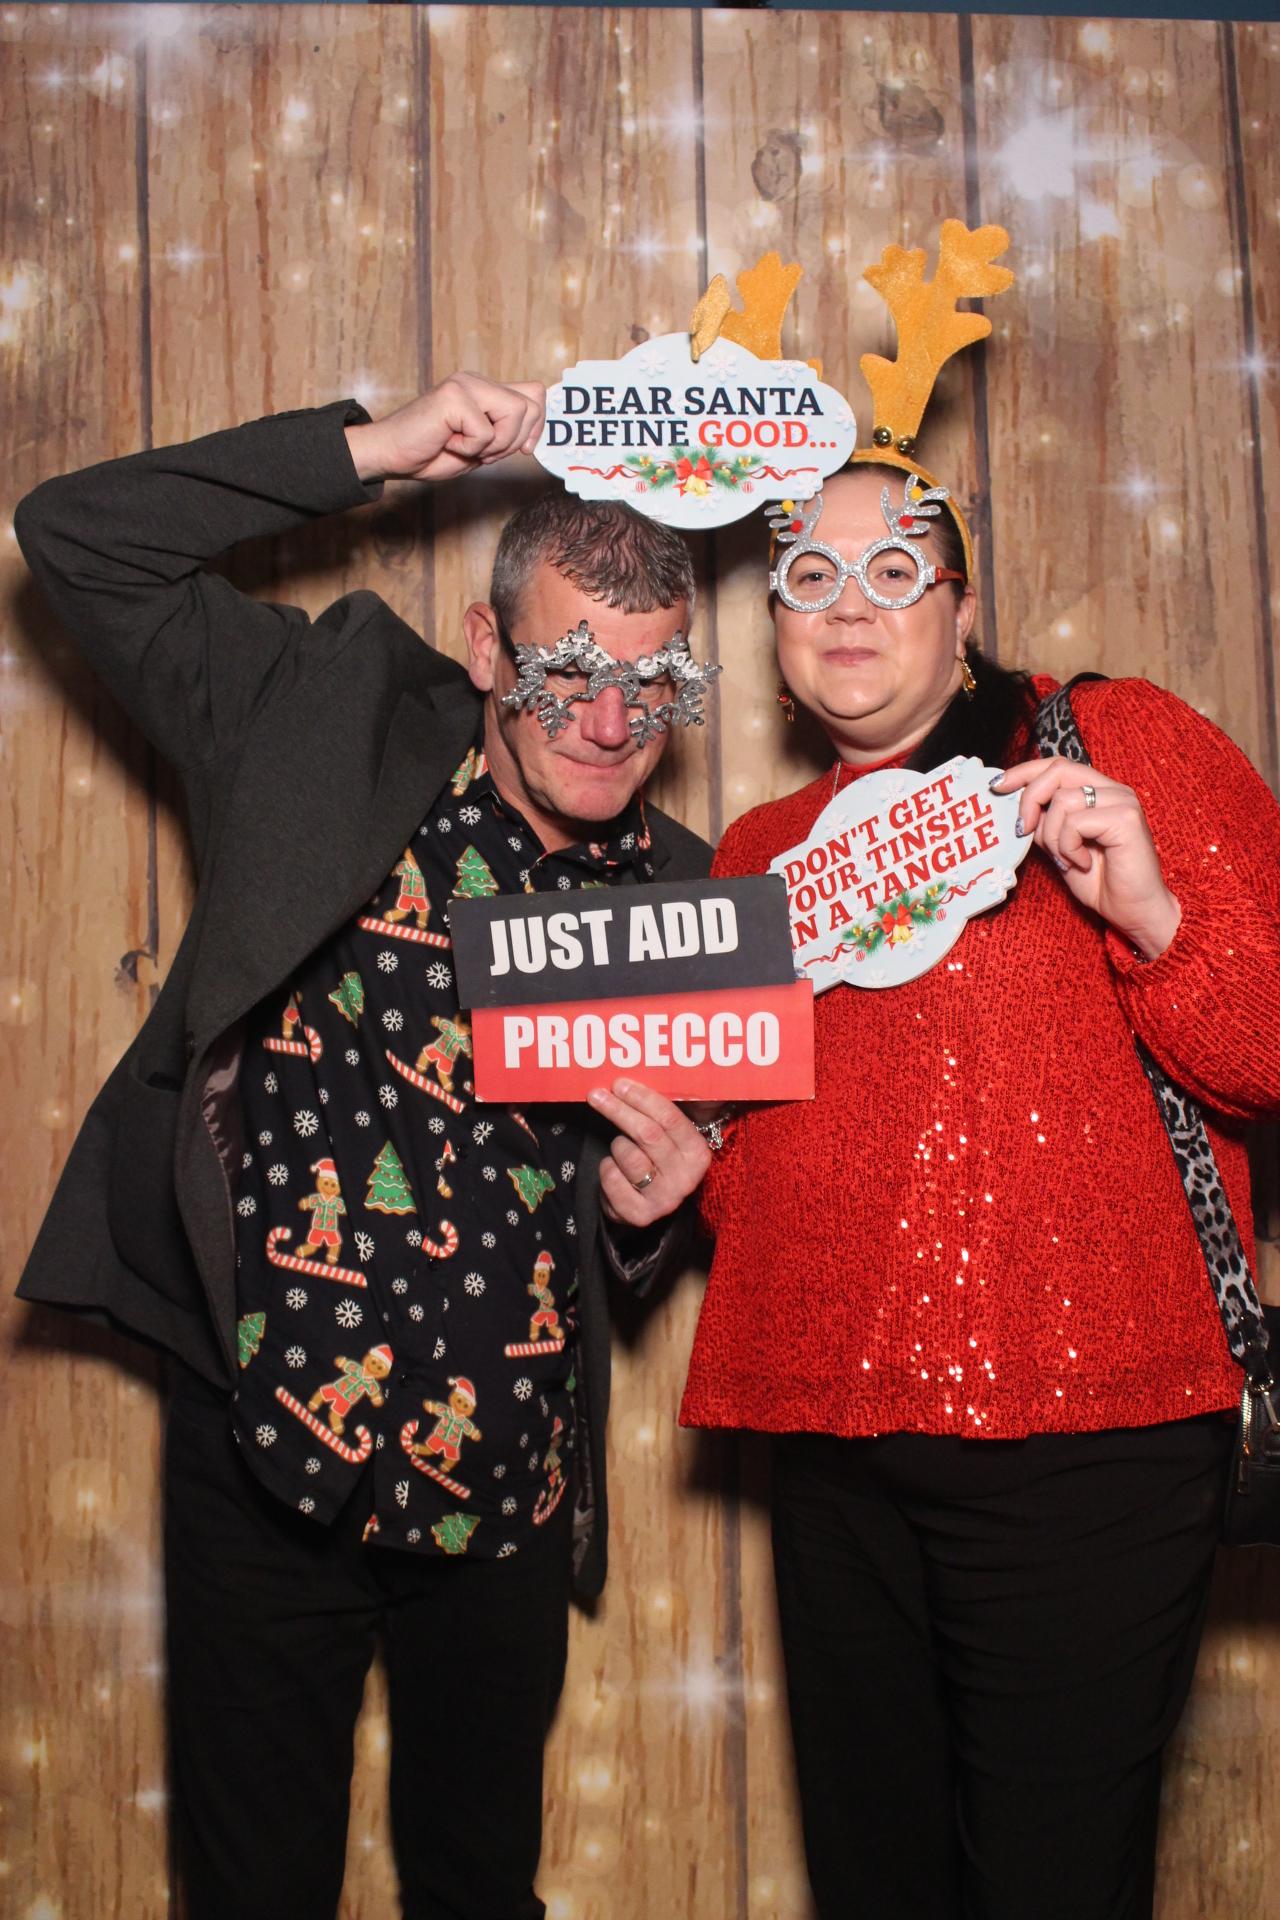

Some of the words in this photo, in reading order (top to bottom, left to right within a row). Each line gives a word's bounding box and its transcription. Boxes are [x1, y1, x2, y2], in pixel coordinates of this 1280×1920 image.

[546, 420, 689, 447] DEFINE
[698, 420, 838, 448] GOOD...
[562, 386, 675, 415] DEAR
[684, 386, 824, 416] SANTA
[784, 816, 880, 889] DON'T
[889, 774, 954, 829] GET
[866, 793, 993, 874] TINSEL
[790, 916, 819, 950] N
[829, 901, 854, 931] A
[856, 820, 1000, 912] TANGLE
[490, 909, 613, 976] JUST
[629, 898, 739, 963] ADD
[503, 1011, 780, 1069] PROSECCO
